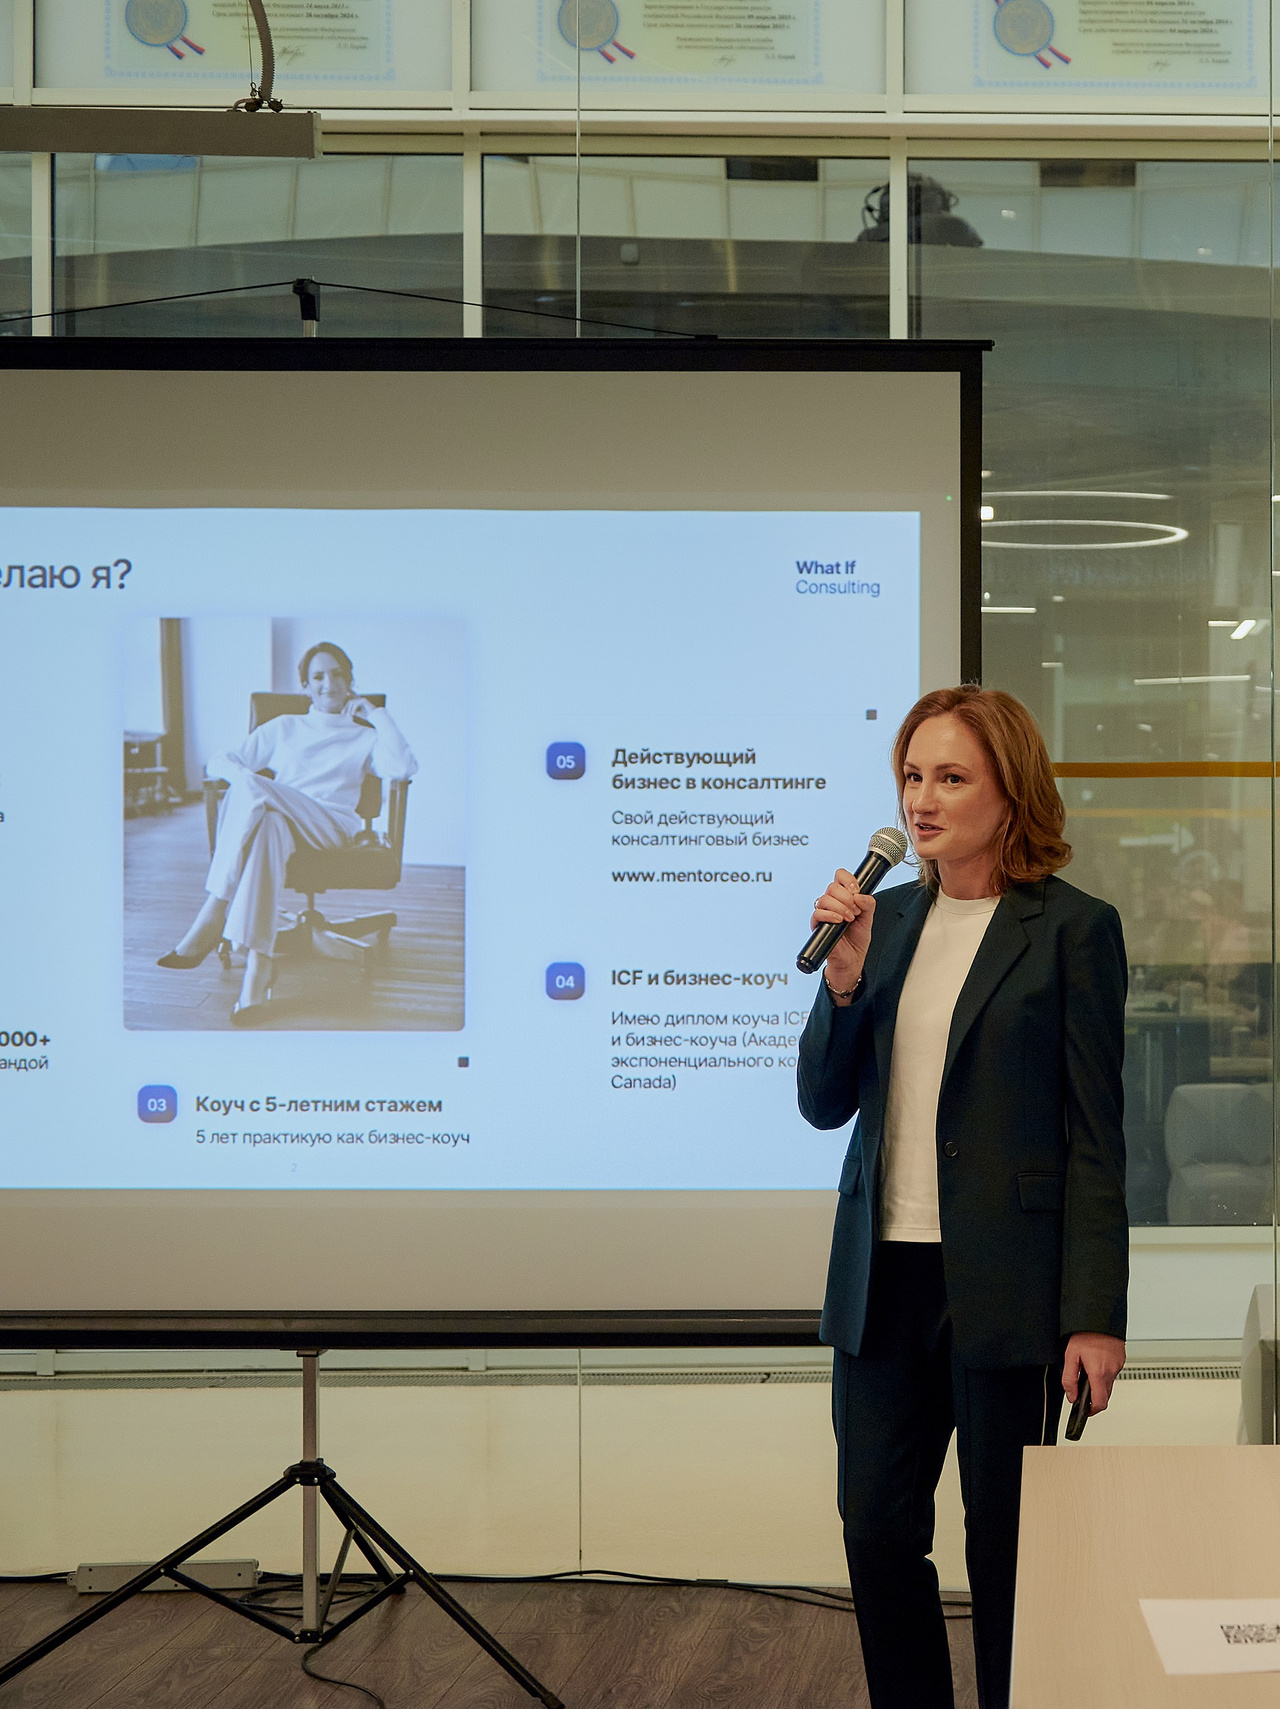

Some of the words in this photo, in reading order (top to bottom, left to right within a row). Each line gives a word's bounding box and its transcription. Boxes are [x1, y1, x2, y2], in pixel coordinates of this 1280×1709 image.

[0, 564, 81, 589] лаю
[91, 558, 132, 589] я?
[795, 560, 841, 575] What
[844, 559, 857, 575] If
[795, 579, 881, 598] Consulting
[556, 755, 576, 769] 05
[611, 747, 756, 769] Действующий
[611, 773, 681, 790] бизнес
[685, 777, 697, 790] в
[701, 777, 827, 790] консалтинге
[611, 810, 654, 825] Свой
[656, 810, 775, 829] действующий
[611, 831, 748, 847] консалтинговый
[751, 831, 809, 847] бизнес
[611, 869, 773, 883] www.mentorceo.ru
[555, 974, 576, 989] 04
[611, 969, 644, 986] ICF
[647, 973, 660, 986] и
[663, 969, 788, 990] бизнес-коуч
[611, 1011, 661, 1026] Имею
[663, 1014, 728, 1028] диплом
[732, 1014, 780, 1029] коуча
[611, 1035, 621, 1047] и
[625, 1032, 737, 1050] бизнес-коуча
[741, 1033, 800, 1049] (Акаде
[611, 1056, 774, 1071] экспоненциального
[610, 1074, 677, 1091] Canada)
[147, 1098, 167, 1112] 03
[195, 1095, 245, 1116] Коуч
[249, 1099, 261, 1113] с
[265, 1096, 361, 1113] 5-летним
[364, 1099, 443, 1113] стажем
[196, 1129, 206, 1144] 5
[209, 1132, 239, 1144] лет
[242, 1132, 333, 1148] практикую
[336, 1132, 365, 1145] как
[368, 1129, 470, 1148] бизнес-коуч
